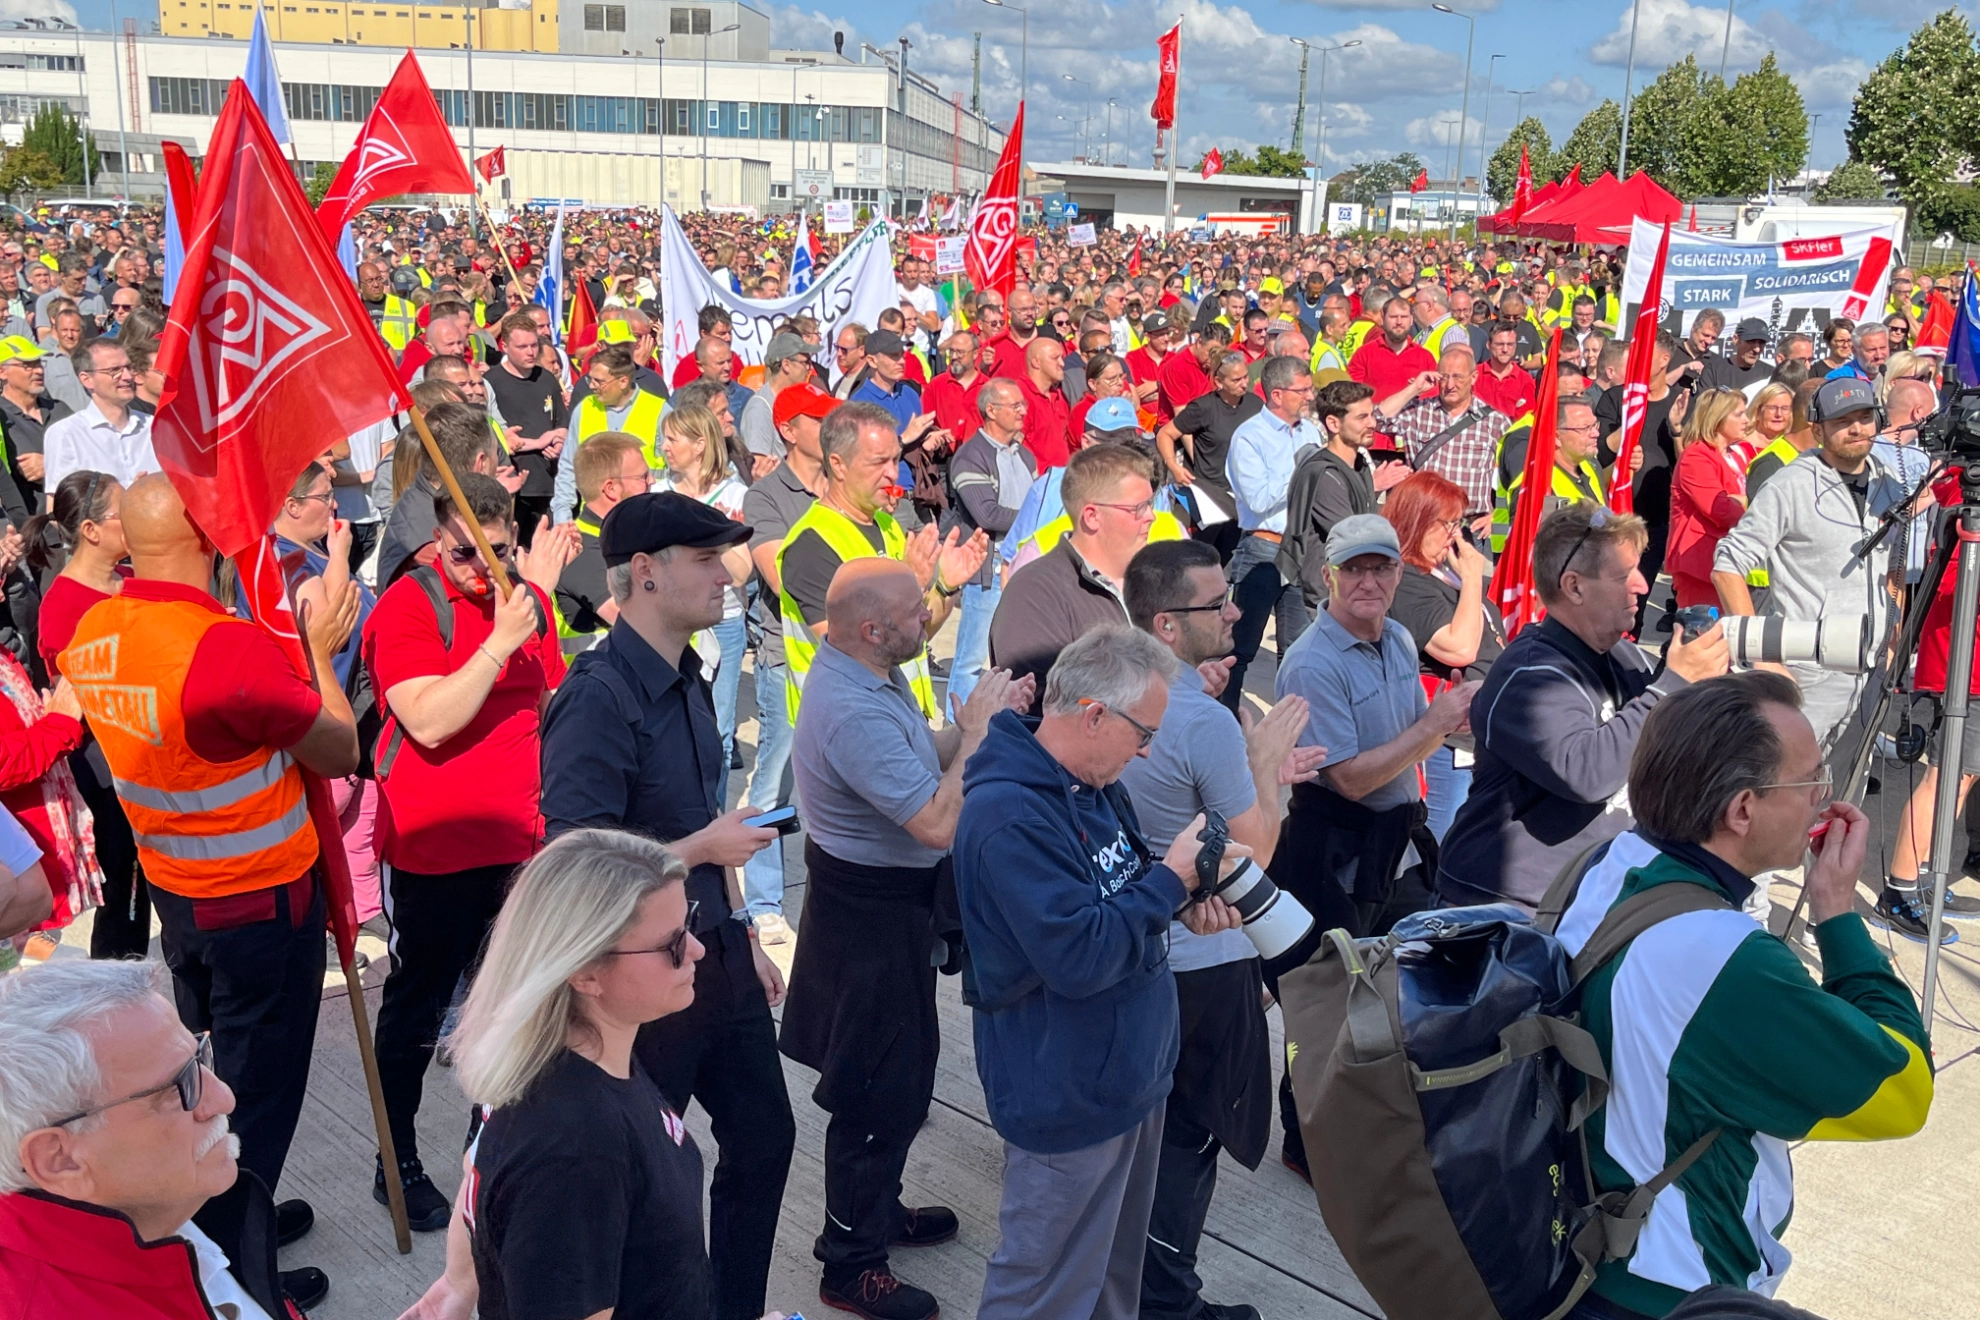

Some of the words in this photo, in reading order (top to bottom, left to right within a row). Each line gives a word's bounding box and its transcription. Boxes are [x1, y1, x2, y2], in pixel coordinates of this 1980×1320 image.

[1671, 252, 1767, 267] GEMEINSAM
[1753, 269, 1850, 290] SOLIDARISCH
[1683, 288, 1732, 303] STARK
[68, 641, 113, 676] TEAM
